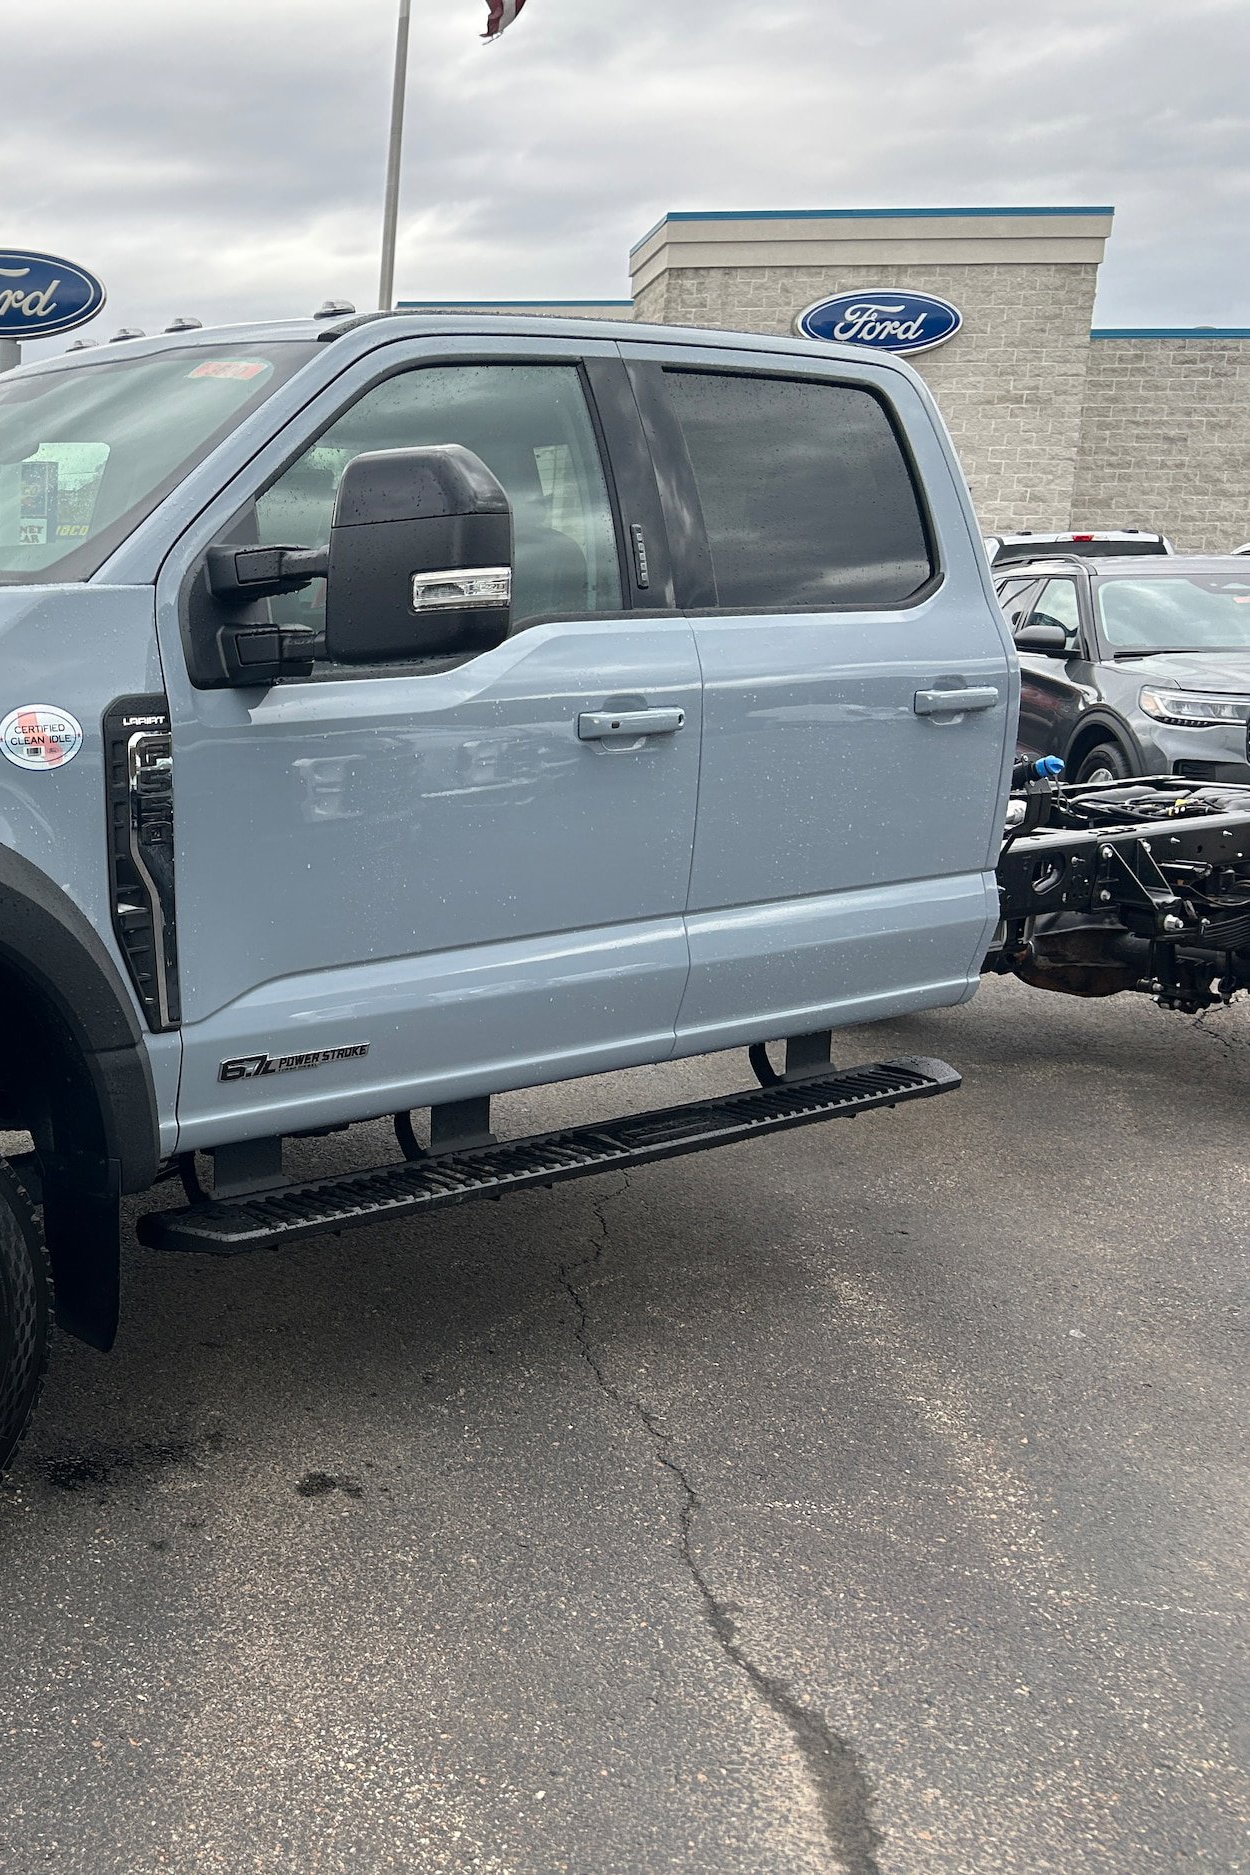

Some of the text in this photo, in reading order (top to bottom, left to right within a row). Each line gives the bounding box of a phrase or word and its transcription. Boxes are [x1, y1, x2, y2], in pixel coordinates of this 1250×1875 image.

[833, 303, 928, 341] Ford
[123, 715, 166, 726] LARIAT
[14, 724, 66, 734] CERTIFIED
[10, 734, 72, 746] CLEAN IDLE
[220, 1054, 276, 1081] 6.7L
[278, 1053, 320, 1068] POWER
[321, 1045, 367, 1060] STROKE
